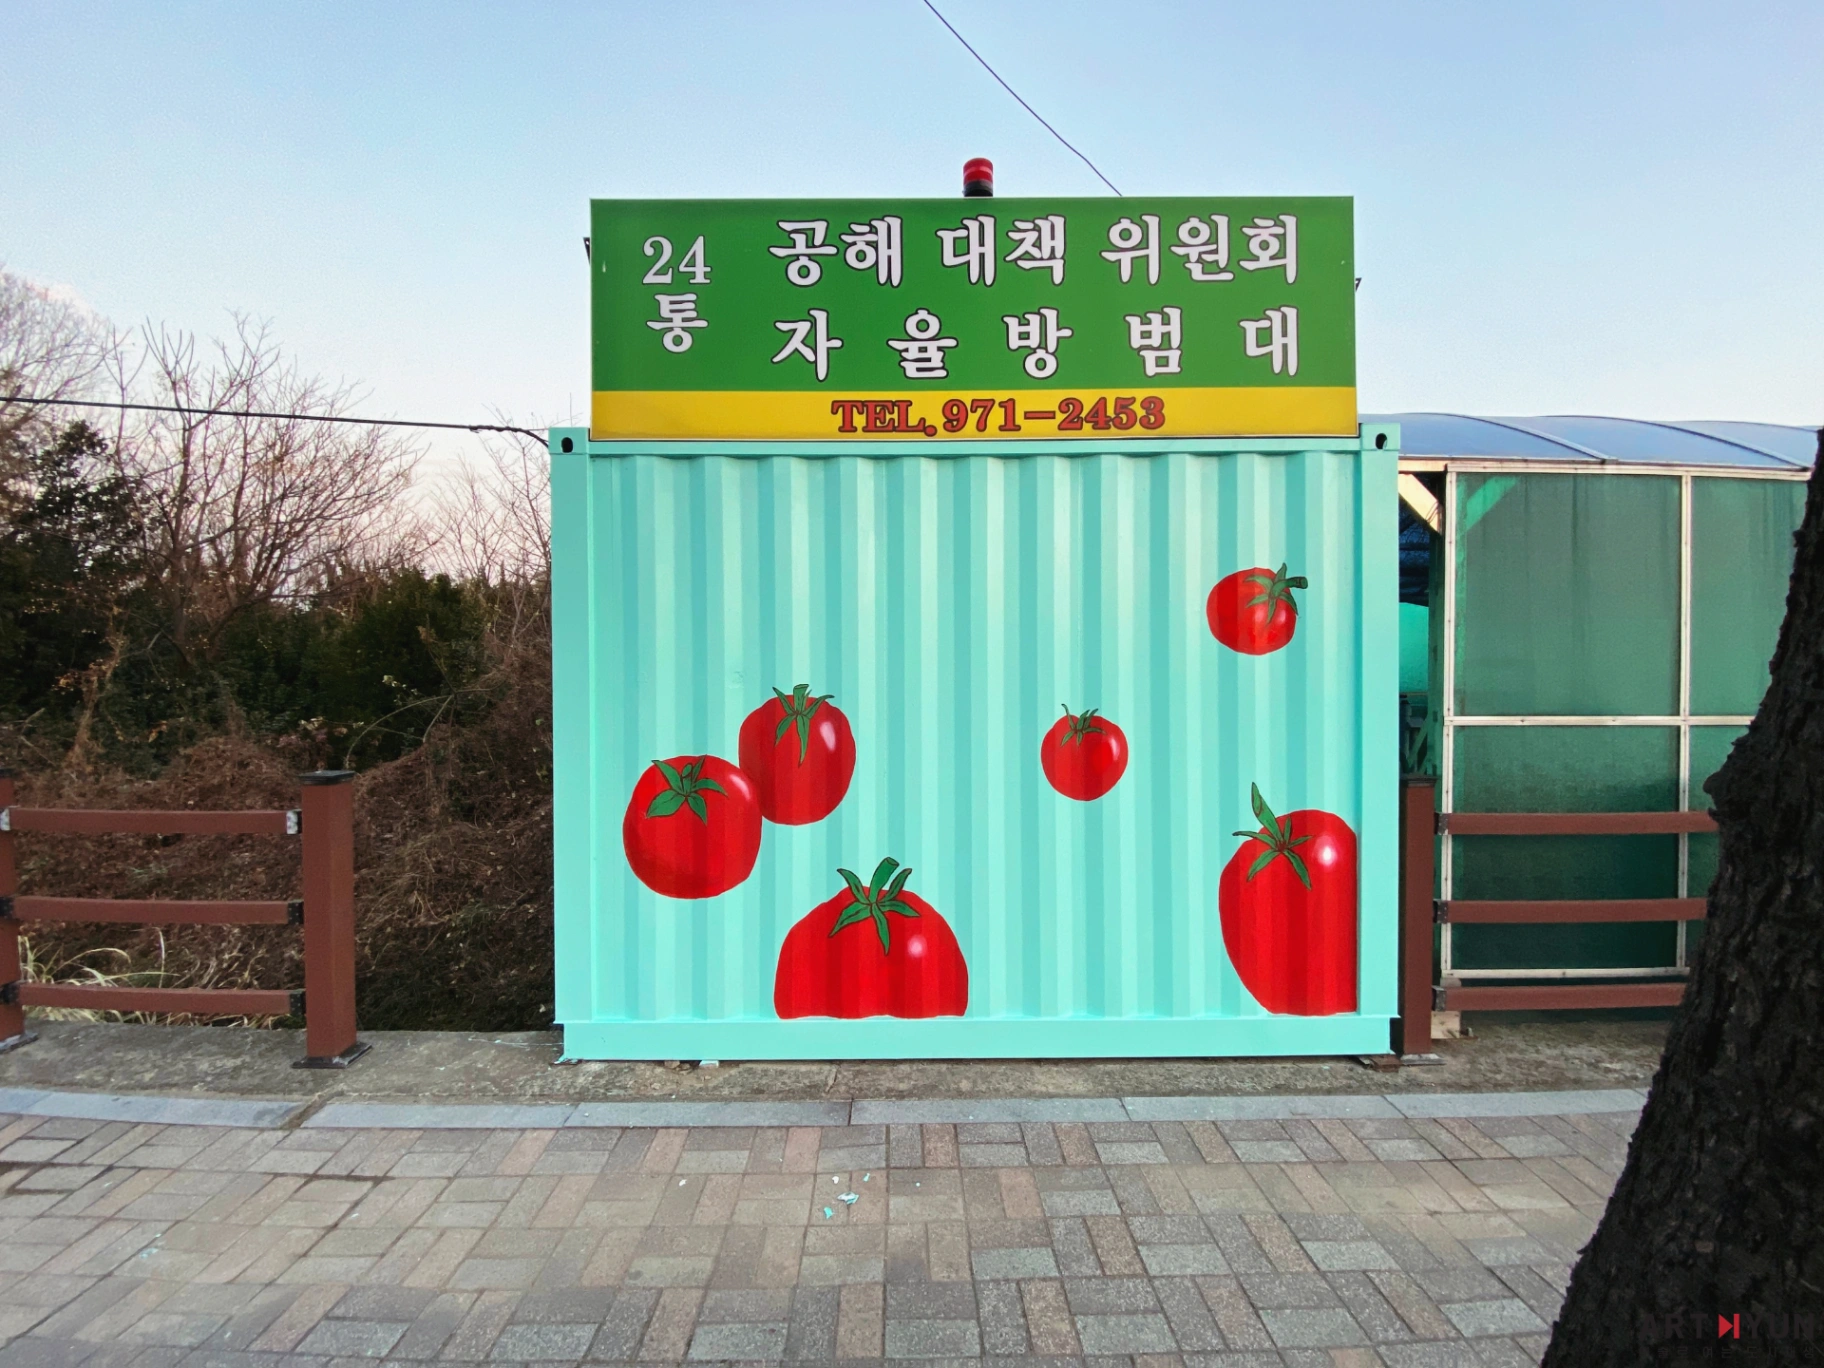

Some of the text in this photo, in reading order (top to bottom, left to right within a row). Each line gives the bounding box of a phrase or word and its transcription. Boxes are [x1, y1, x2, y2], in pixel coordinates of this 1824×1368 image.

[641, 234, 713, 286] 24
[767, 213, 1299, 288] 공해 대책 위원회
[645, 292, 710, 354] 통
